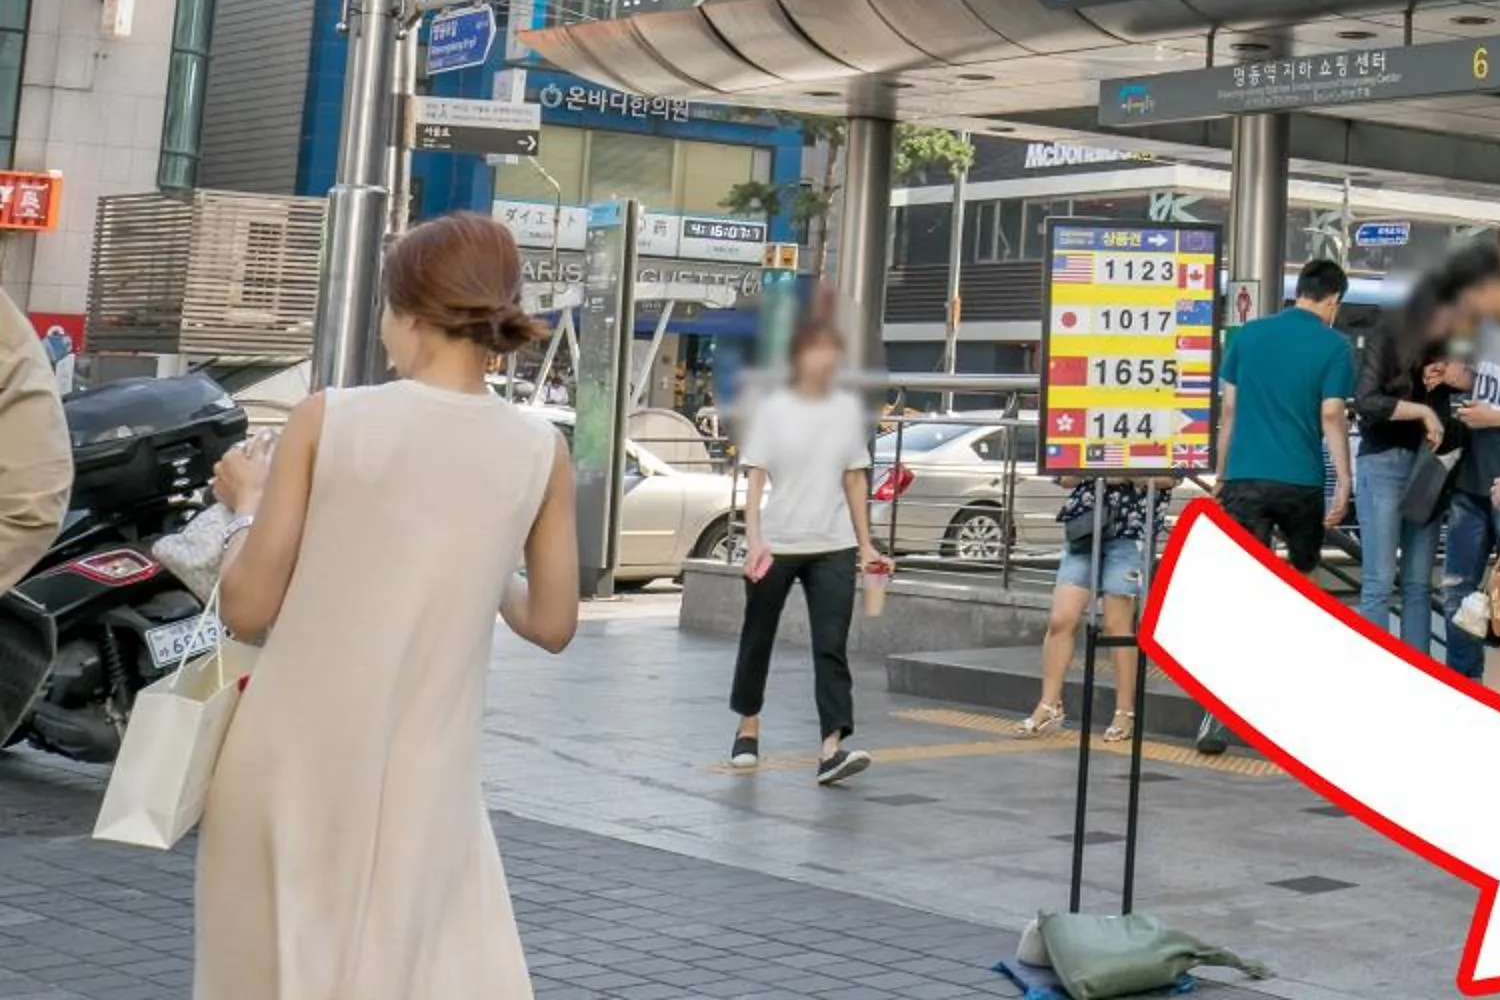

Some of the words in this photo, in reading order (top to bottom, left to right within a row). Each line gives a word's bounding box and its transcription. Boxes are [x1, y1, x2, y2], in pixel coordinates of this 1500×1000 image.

[1233, 64, 1277, 87] 명동역
[1284, 59, 1312, 84] 지하
[1319, 55, 1349, 77] 쇼핑
[1355, 51, 1386, 75] 센터
[1473, 47, 1489, 79] 6
[565, 85, 689, 122] 온바디한의원
[505, 207, 576, 225] ダイエト
[522, 261, 582, 283] ARIS
[1105, 259, 1173, 280] 1123
[1101, 309, 1171, 331] 1017
[1095, 359, 1178, 386] 1655
[1093, 413, 1152, 439] 144
